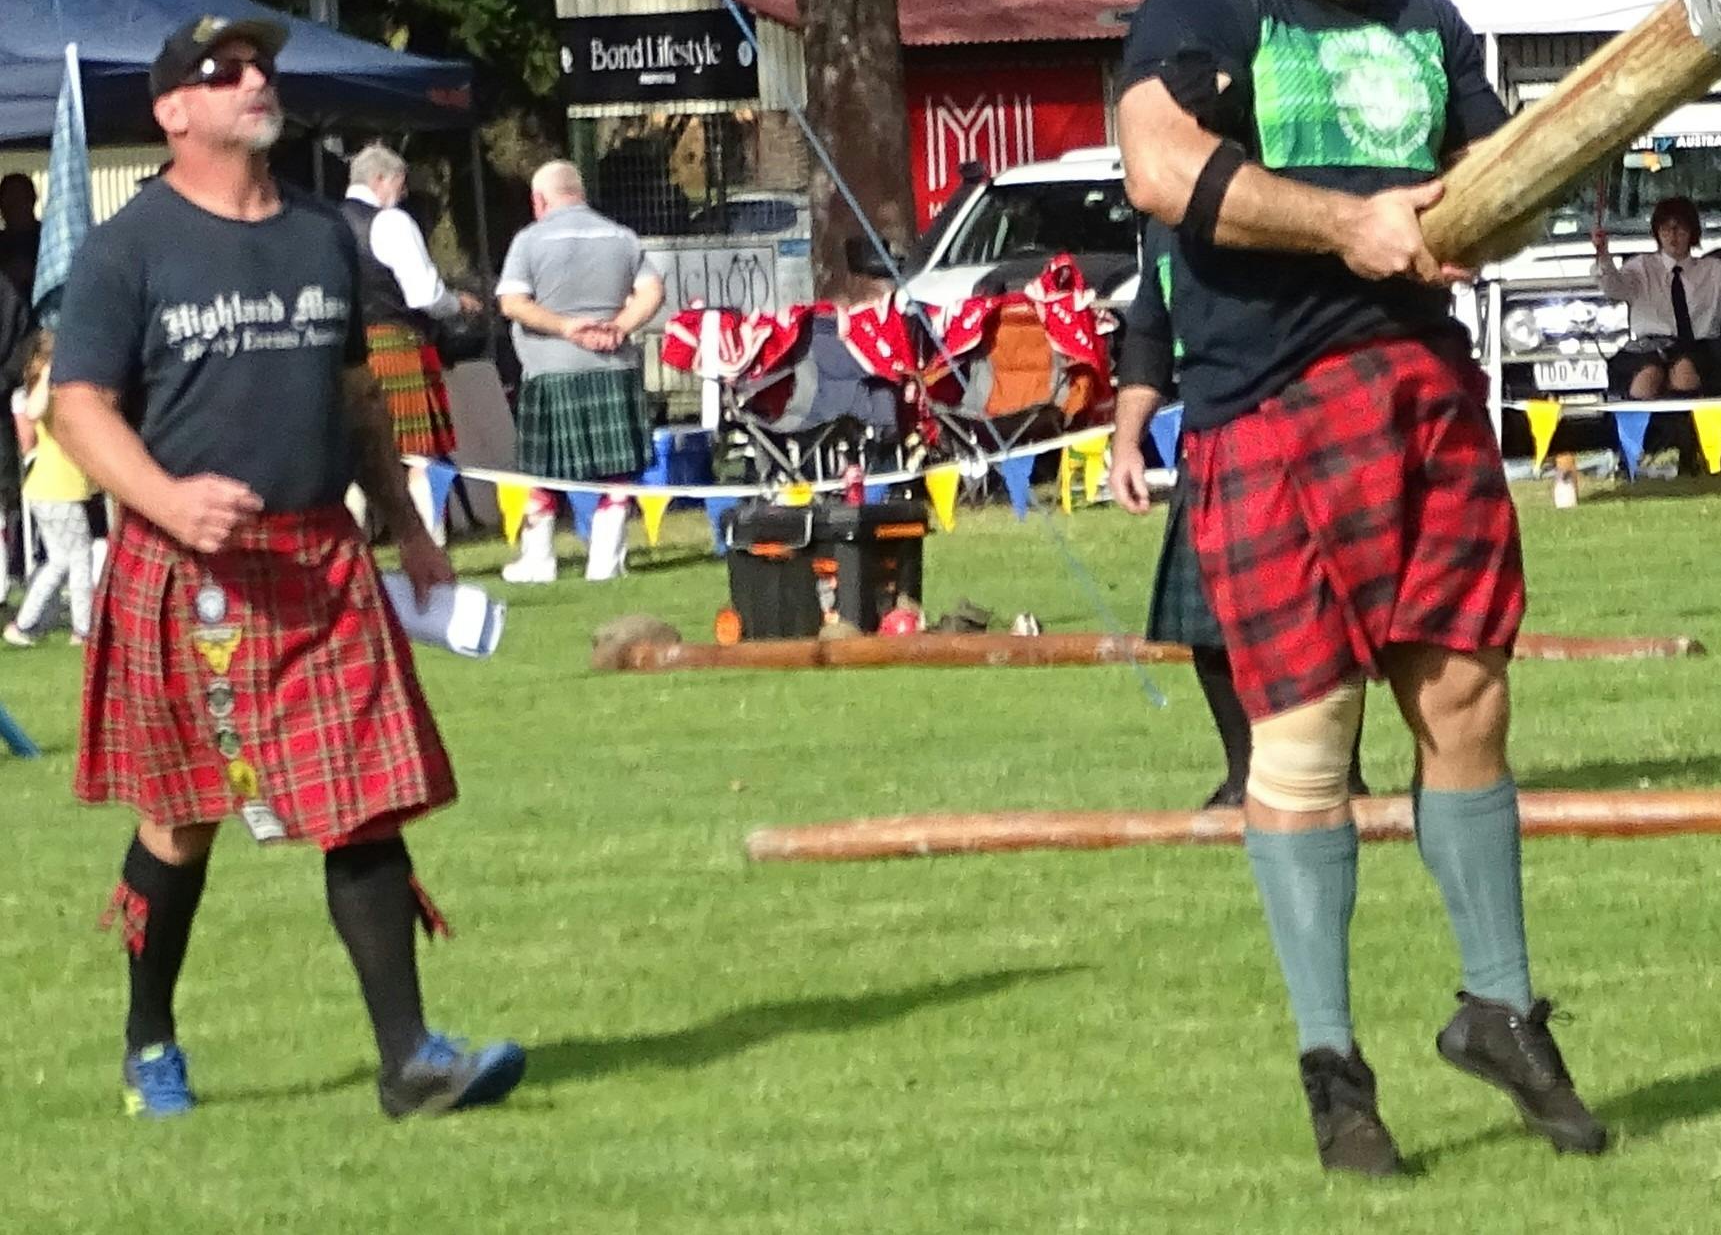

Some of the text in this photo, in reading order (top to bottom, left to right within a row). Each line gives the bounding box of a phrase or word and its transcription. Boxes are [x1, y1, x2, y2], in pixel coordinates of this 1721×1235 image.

[590, 32, 722, 74] Bond Lifestyle
[160, 290, 285, 348] Highland
